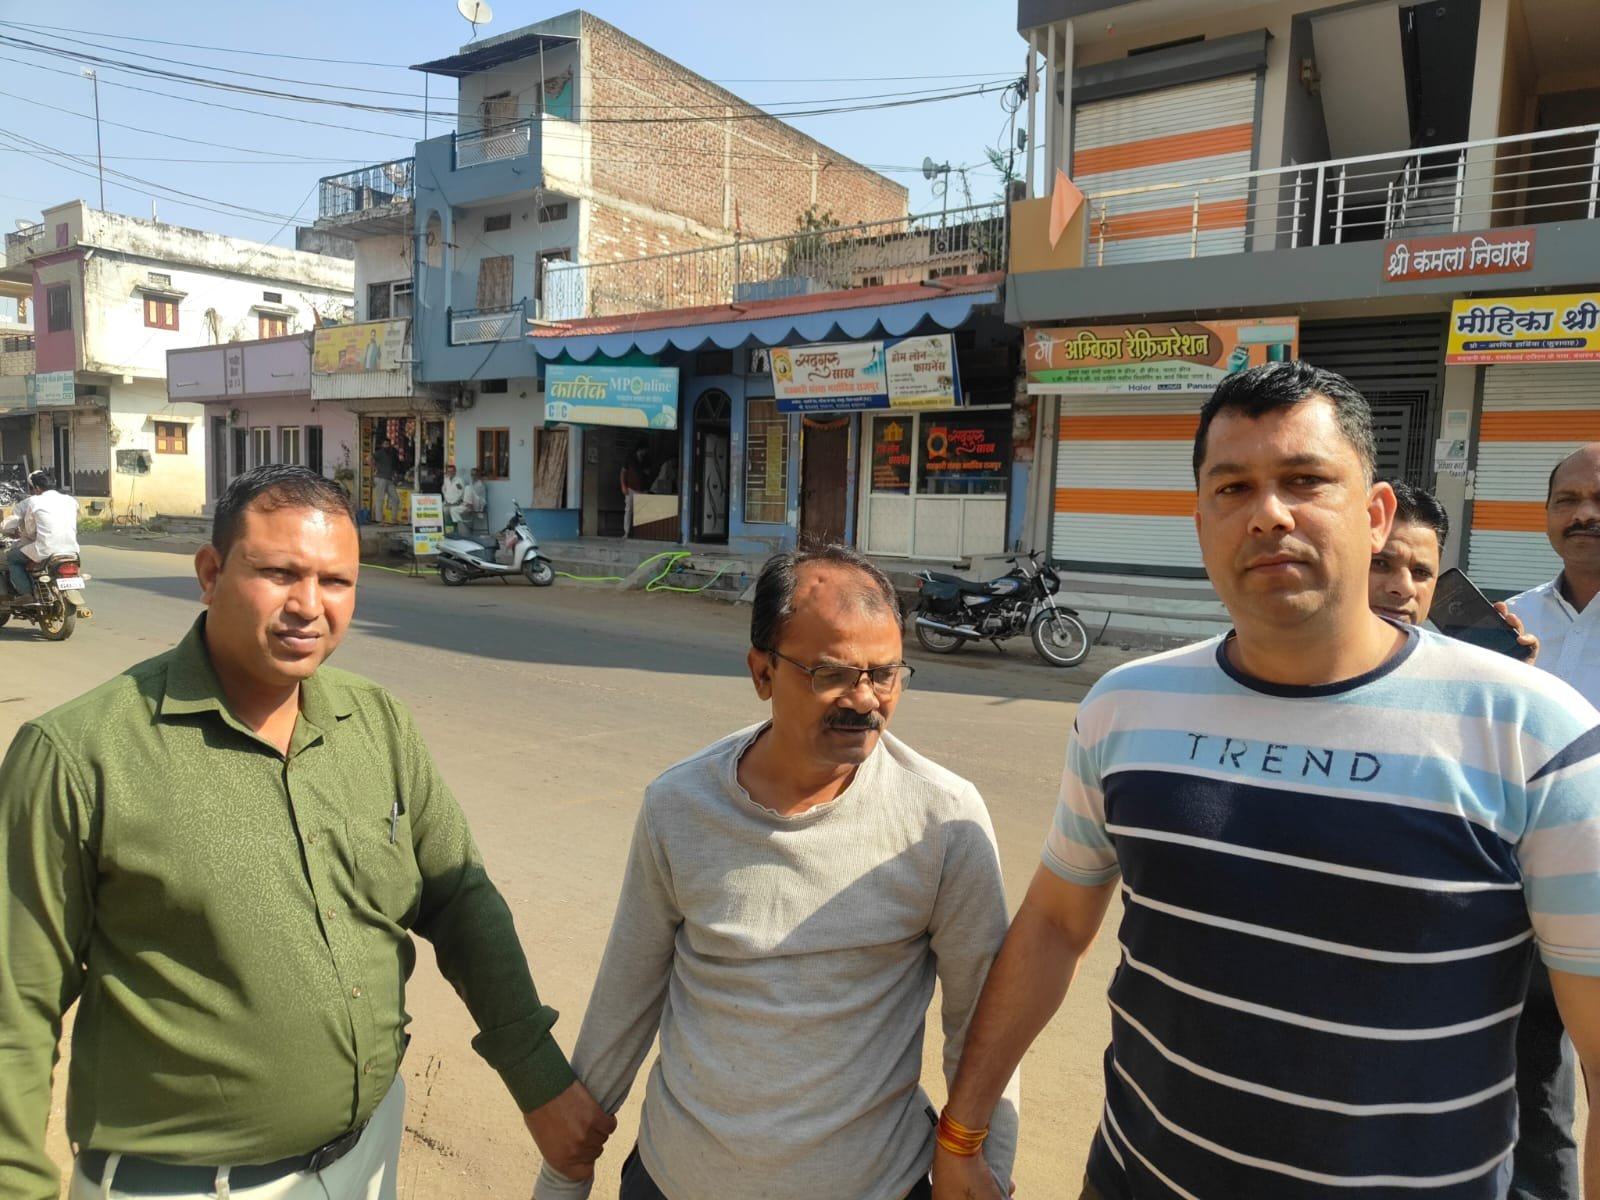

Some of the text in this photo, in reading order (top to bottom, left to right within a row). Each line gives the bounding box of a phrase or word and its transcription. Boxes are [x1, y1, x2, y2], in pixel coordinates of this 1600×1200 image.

[1387, 236, 1531, 277] श्री कमला निवास
[1457, 302, 1600, 336] मीहिका श्री
[1064, 330, 1122, 361] अम्बिका
[1124, 327, 1210, 361] रेफ्रिजरेशन
[891, 348, 927, 363] होम लोन
[832, 368, 856, 380] साख
[549, 375, 609, 400] कार्तिक
[1128, 383, 1152, 391] Haier
[1187, 382, 1219, 390] Panaso
[548, 405, 568, 418] CC
[1187, 732, 1382, 783] TREND
